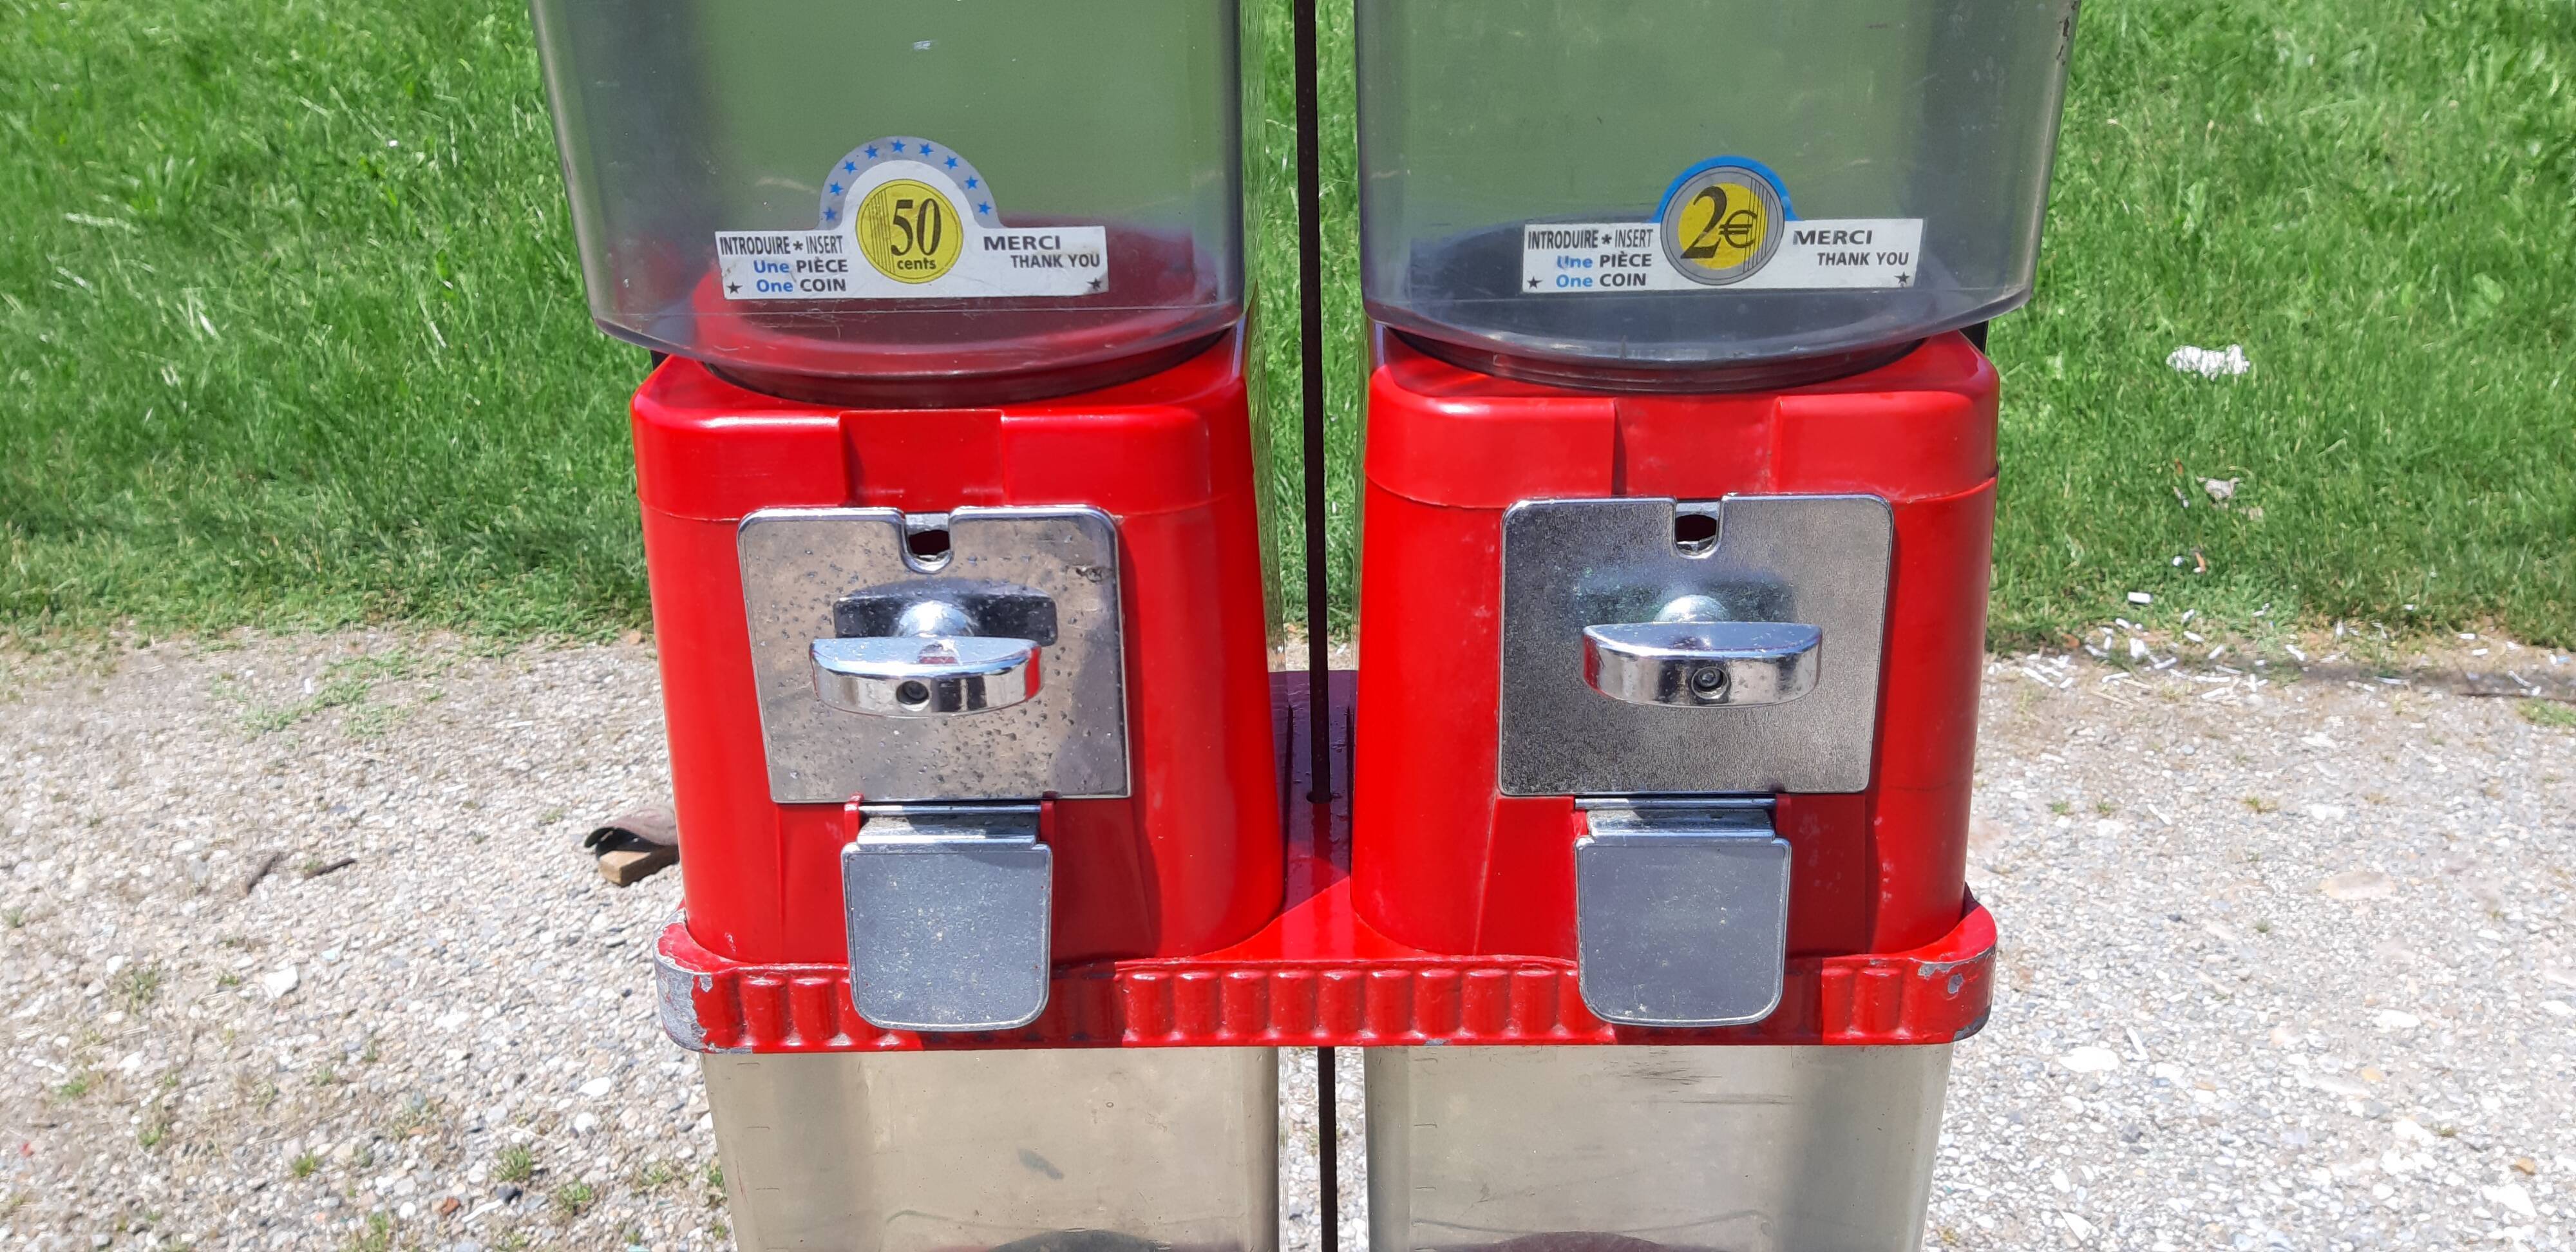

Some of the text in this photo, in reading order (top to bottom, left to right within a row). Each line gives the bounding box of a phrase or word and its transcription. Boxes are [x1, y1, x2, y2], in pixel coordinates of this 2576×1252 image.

[891, 198, 942, 256] 50
[720, 235, 843, 255] INTRODUIRE INSERT
[983, 236, 1061, 251] MERCI
[1528, 229, 1653, 250] INTRODUIRE INSERT
[1793, 230, 1873, 245] MERCI
[753, 256, 848, 273] Une PIÈCE
[897, 258, 937, 270] cents
[1011, 254, 1100, 269] THANK YOU
[1557, 251, 1653, 269] Une PIÈCE
[1817, 252, 1909, 267] THANK YOU
[757, 278, 846, 292] One COIN
[1556, 273, 1647, 289] One COIN
